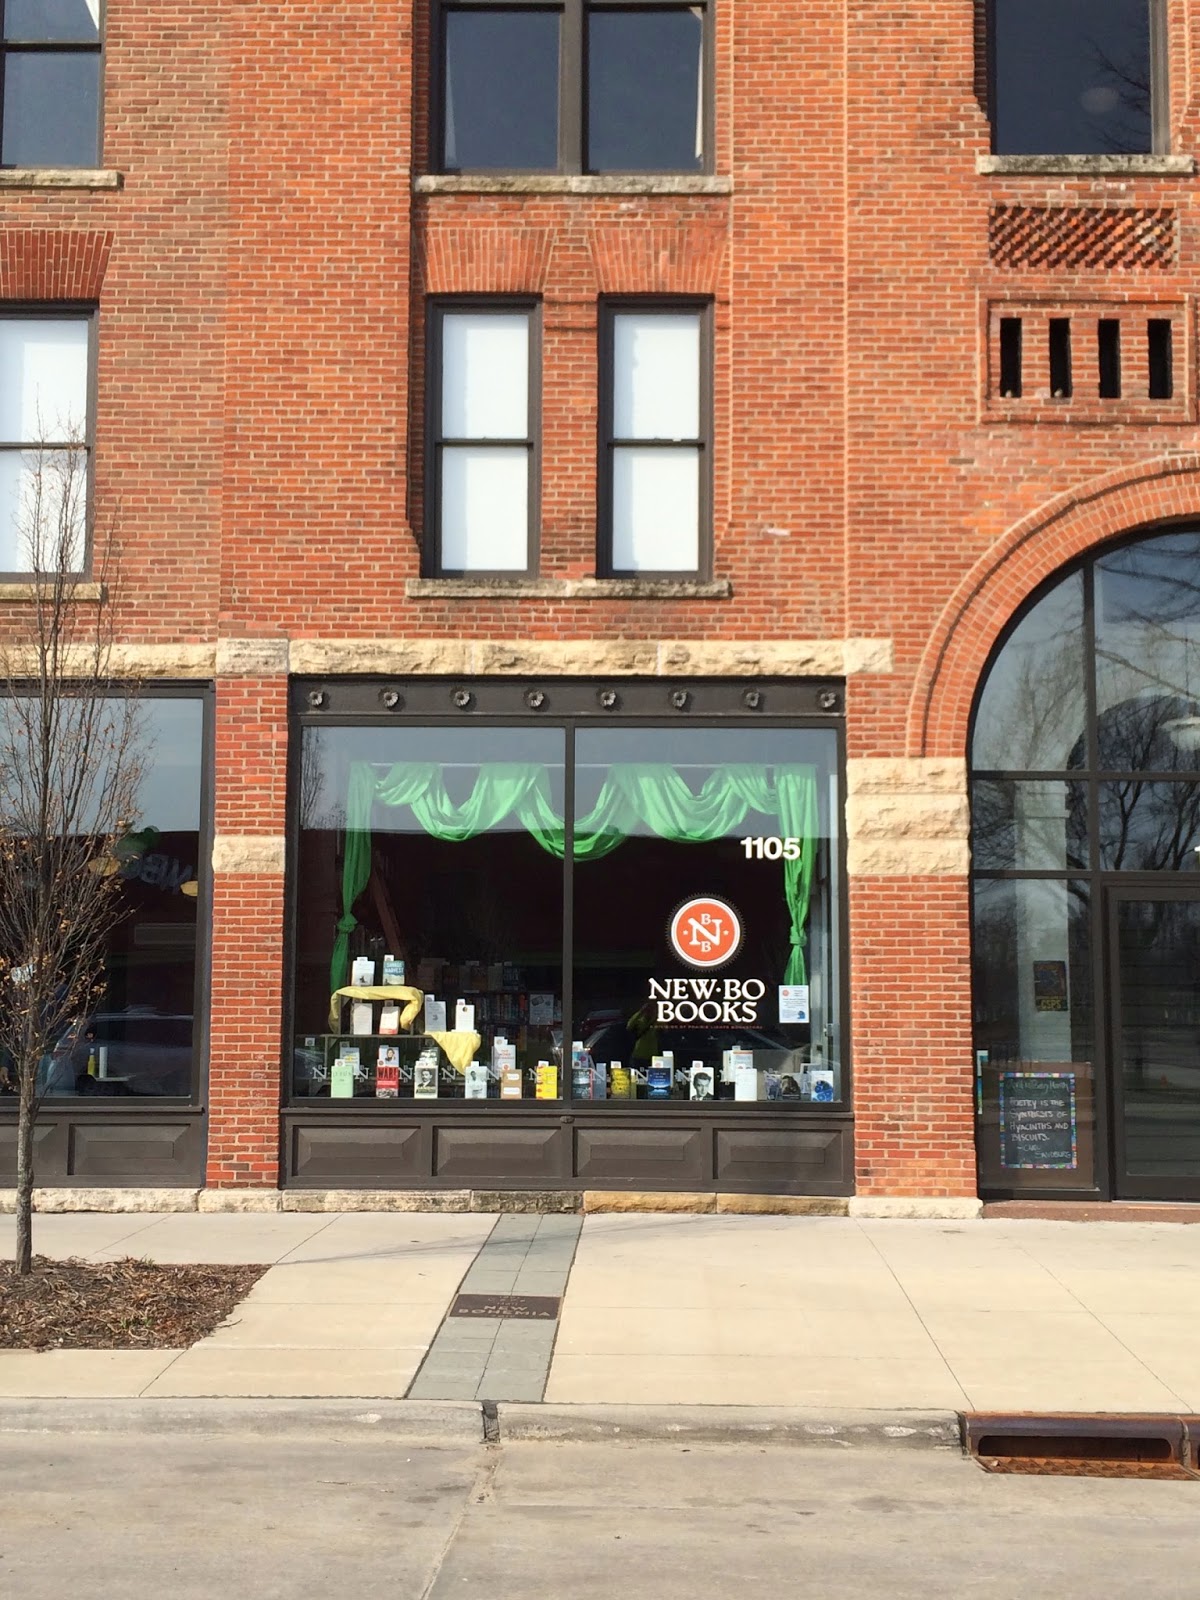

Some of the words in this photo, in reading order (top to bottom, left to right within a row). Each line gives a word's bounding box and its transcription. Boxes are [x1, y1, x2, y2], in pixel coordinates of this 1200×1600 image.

[740, 836, 801, 861] 1105
[656, 1000, 758, 1023] BOOKS
[1040, 1099, 1049, 1107] IS
[1050, 1099, 1065, 1107] THE
[458, 1308, 551, 1317] BOHEMIA
